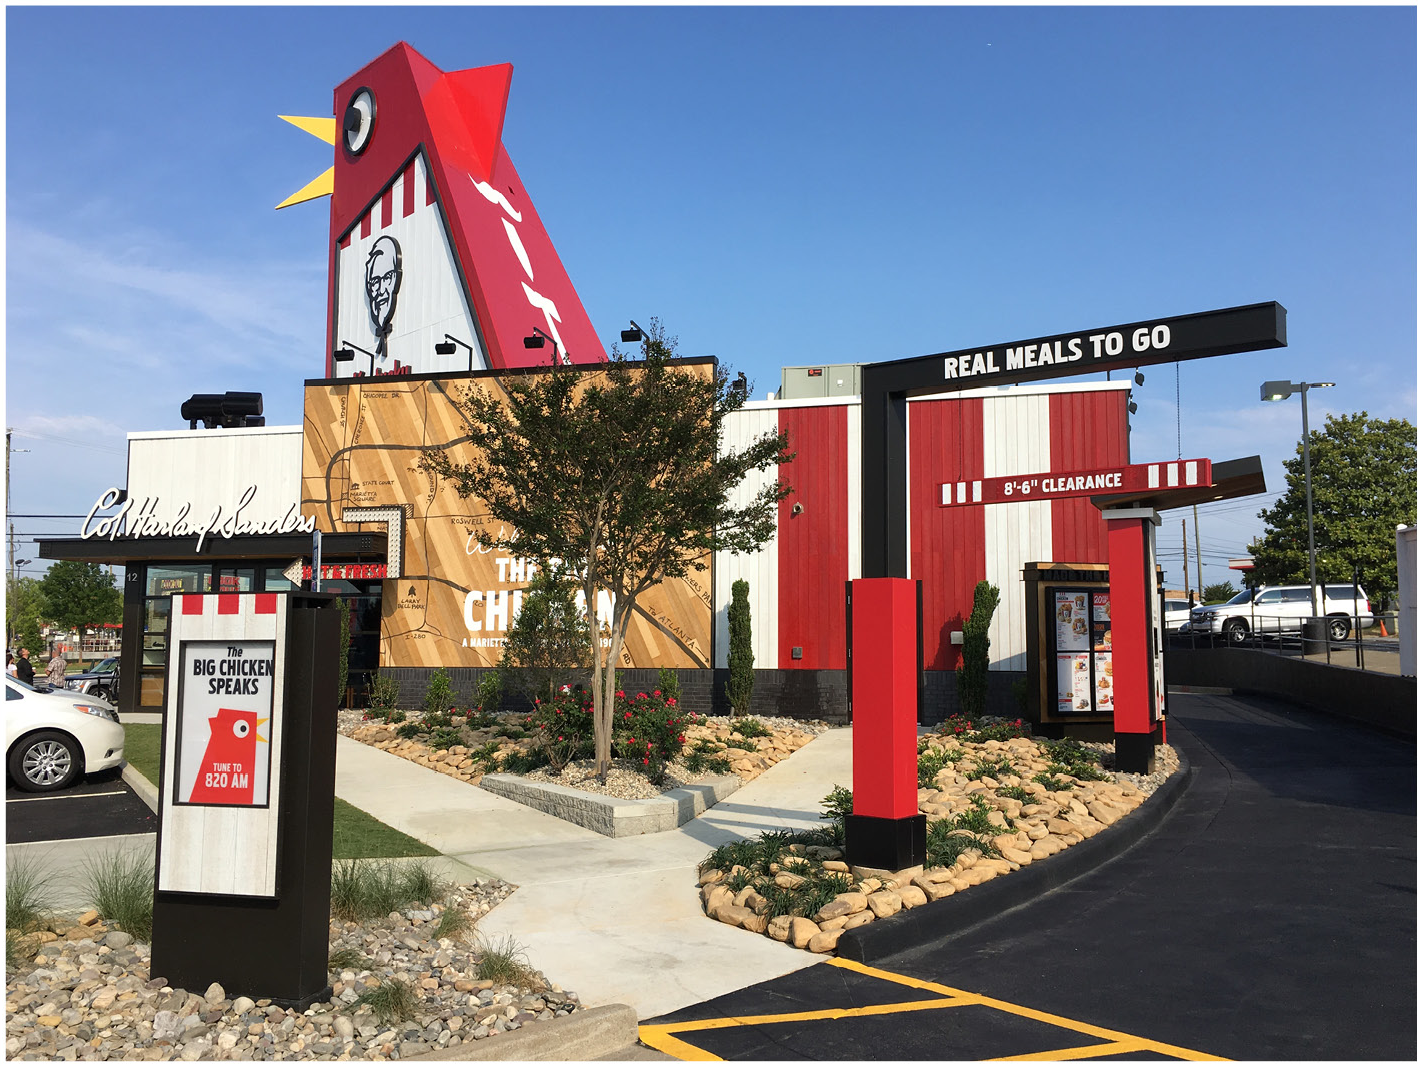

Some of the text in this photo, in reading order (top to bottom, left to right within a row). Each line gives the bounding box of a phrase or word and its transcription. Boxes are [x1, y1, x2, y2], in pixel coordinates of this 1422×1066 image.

[944, 324, 1170, 379] REAL MEALS TO GO
[1004, 473, 1122, 495] 8'-6" CLEARANCE
[80, 488, 134, 541] Col.
[218, 484, 316, 539] Sanders
[126, 572, 138, 582] 12
[302, 564, 387, 579] HT & FRESH
[658, 615, 695, 650] ATLANTA
[462, 638, 467, 647] A
[470, 638, 509, 647] MARIETT
[227, 646, 243, 657] The
[193, 659, 274, 676] BIG CHICKEN
[208, 678, 259, 695] SPEAKS
[213, 763, 242, 772] TUNE TO
[205, 773, 248, 788] 820 AM
